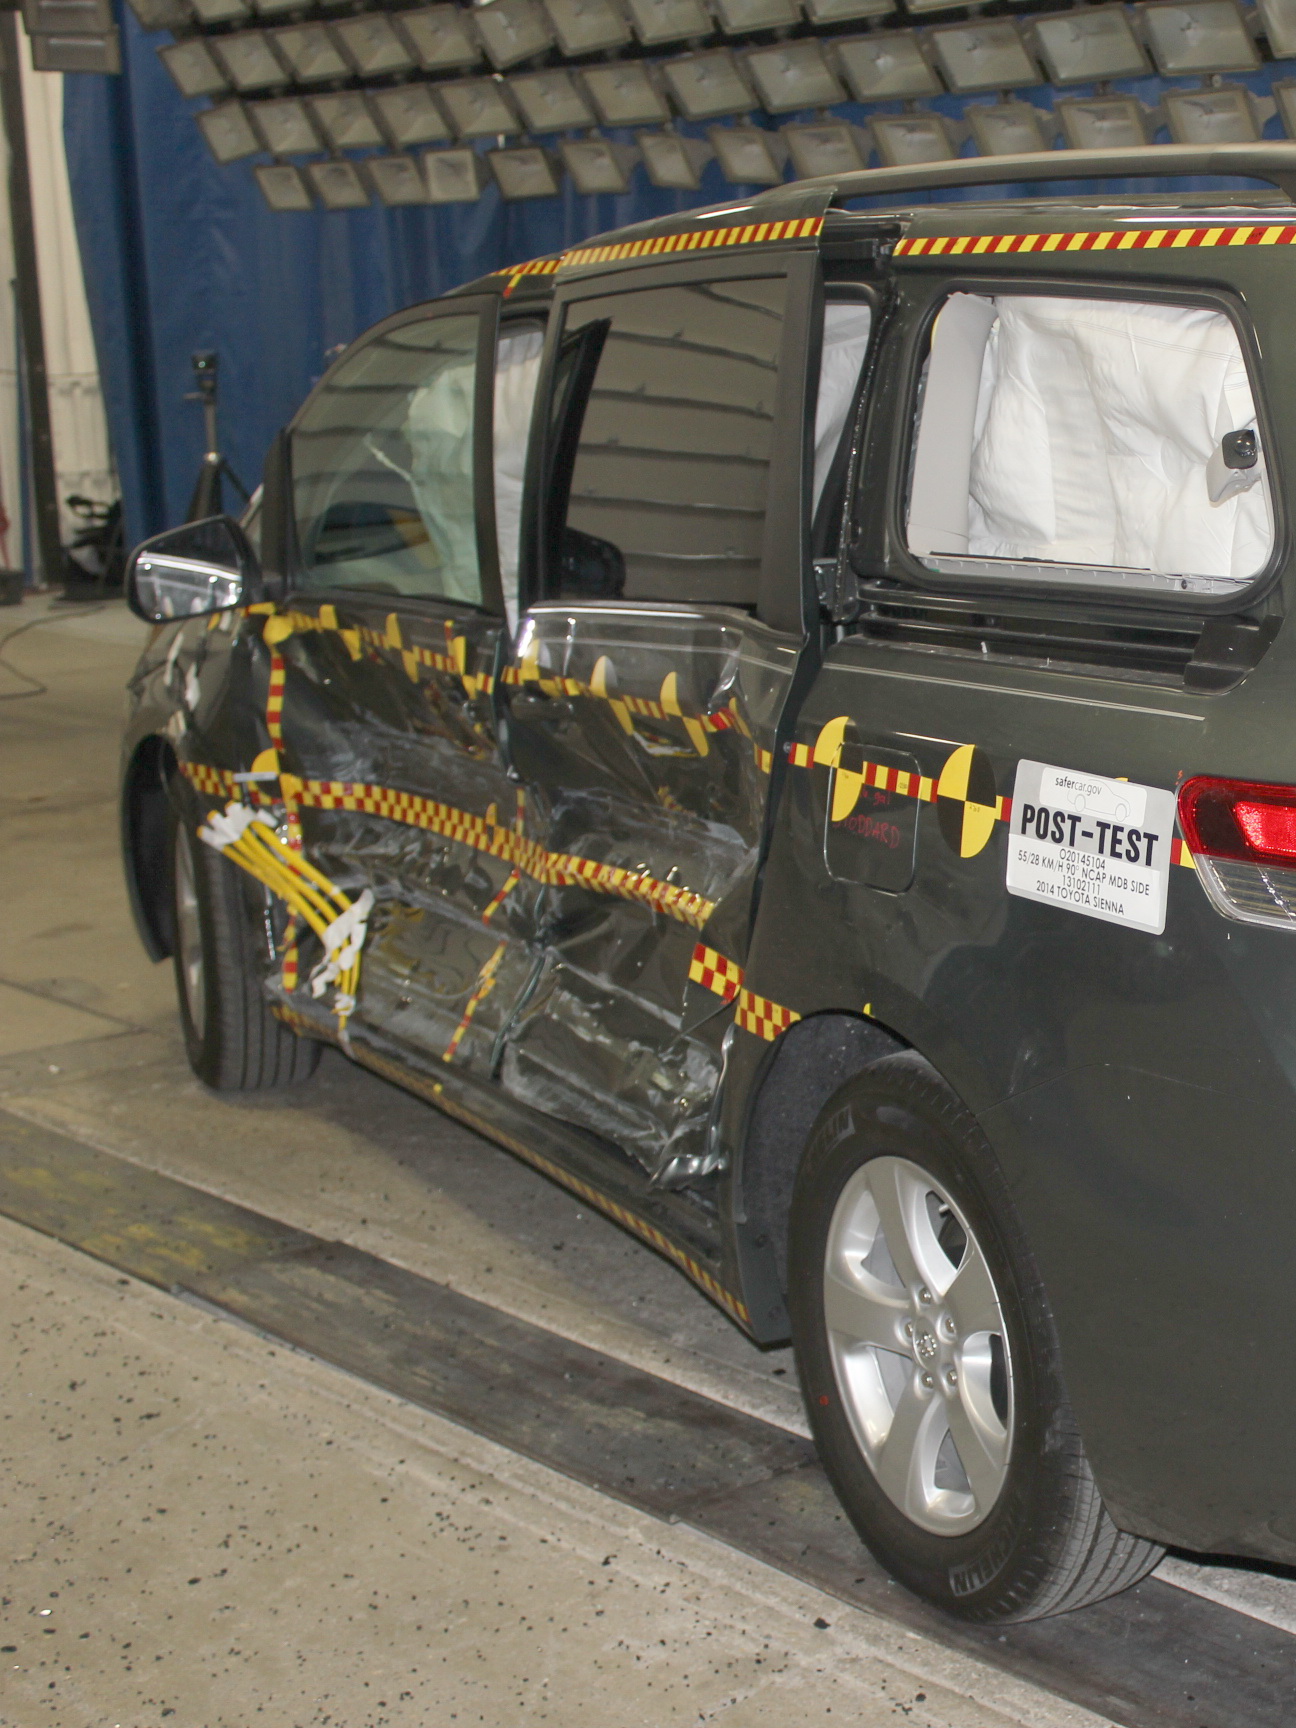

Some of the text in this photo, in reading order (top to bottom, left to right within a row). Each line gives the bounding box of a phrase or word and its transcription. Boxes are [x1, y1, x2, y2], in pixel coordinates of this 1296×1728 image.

[1055, 776, 1102, 796] safercar.gov
[1021, 804, 1159, 867] POST-TEST
[1017, 850, 1040, 866] 55/28
[1041, 856, 1064, 872] KM/H
[1082, 869, 1106, 884] NCAP
[1109, 874, 1128, 890] MDB
[1131, 880, 1150, 896] SIDE
[1062, 875, 1101, 895] 13102111
[1036, 880, 1124, 915] 2014 TOYOTA SIENNA
